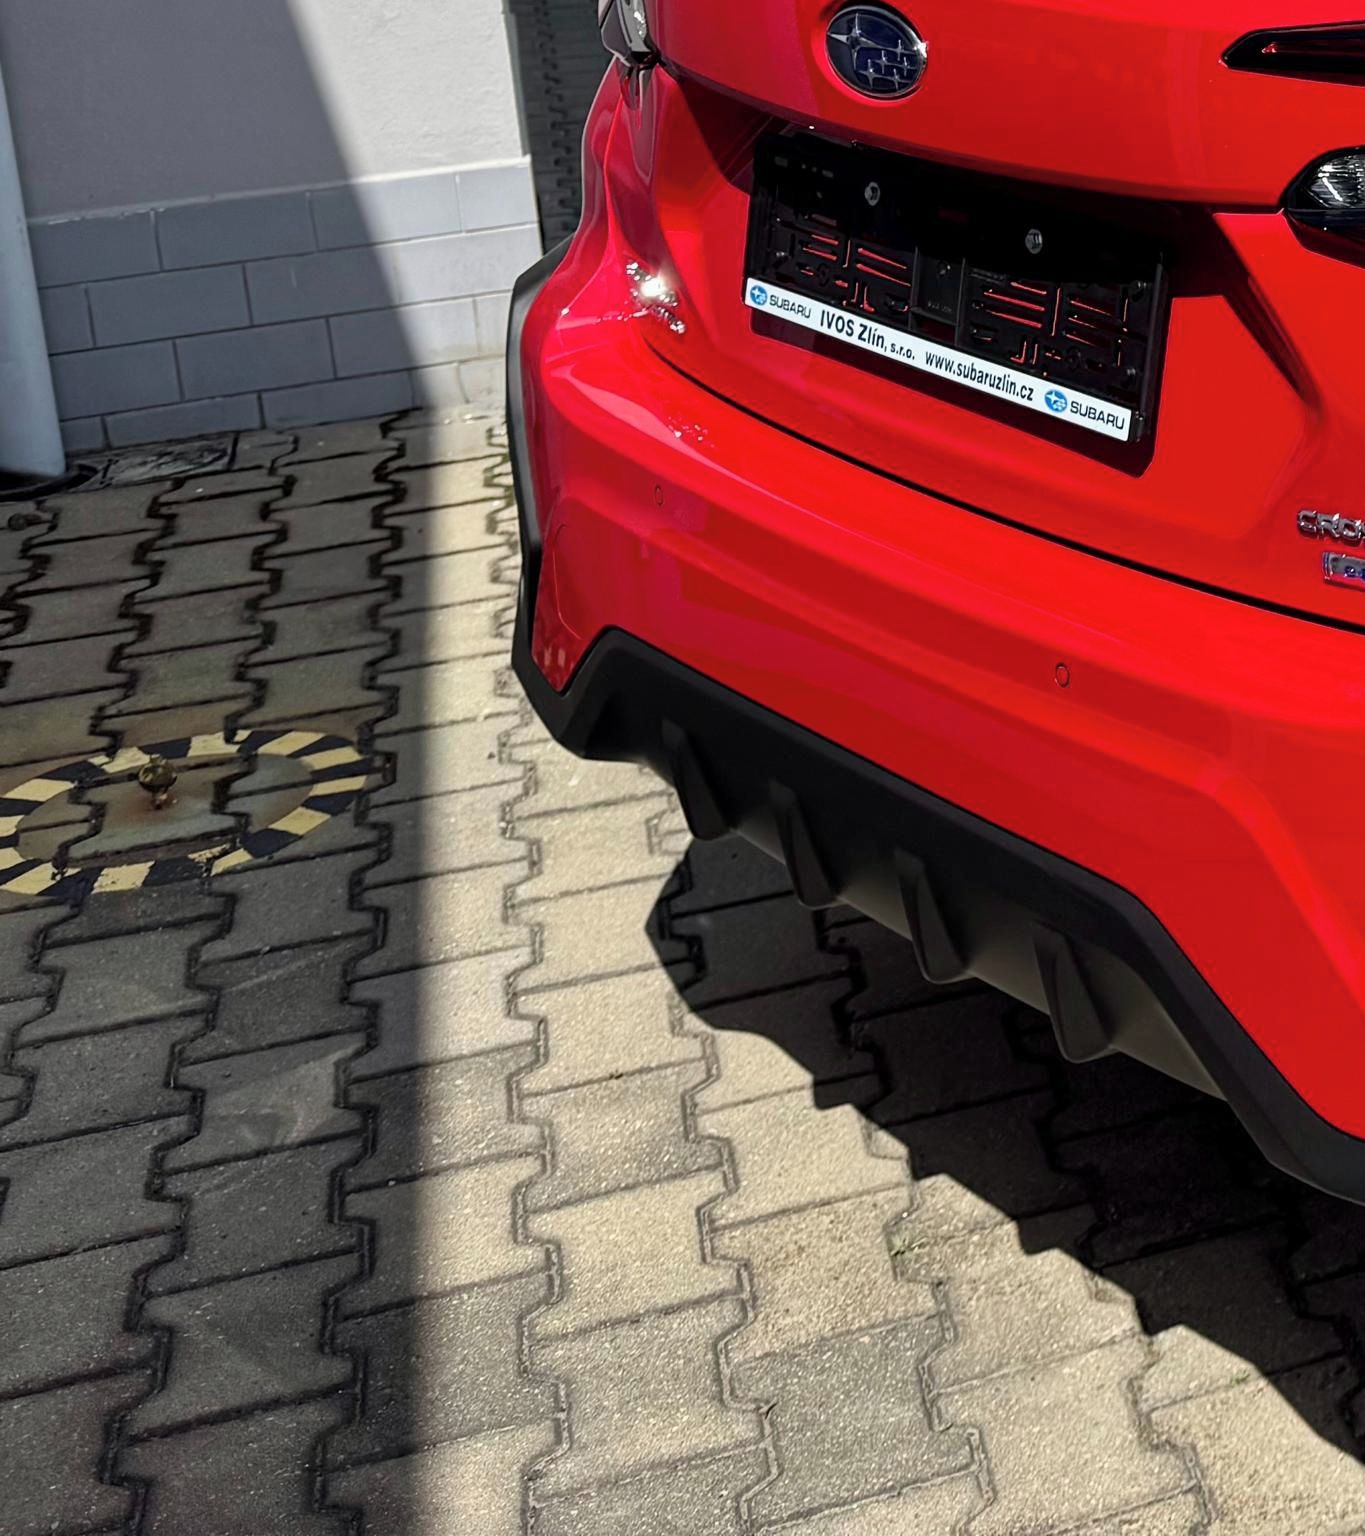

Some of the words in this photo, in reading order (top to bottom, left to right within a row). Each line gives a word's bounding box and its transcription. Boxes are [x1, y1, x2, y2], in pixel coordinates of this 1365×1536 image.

[769, 294, 812, 319] SUBARU
[820, 309, 855, 337] IVOS
[857, 323, 888, 353] Zlín,
[890, 343, 916, 360] s.r.o.
[925, 351, 1035, 402] www.subaruzlin.cz
[1070, 400, 1126, 430] SUBARU
